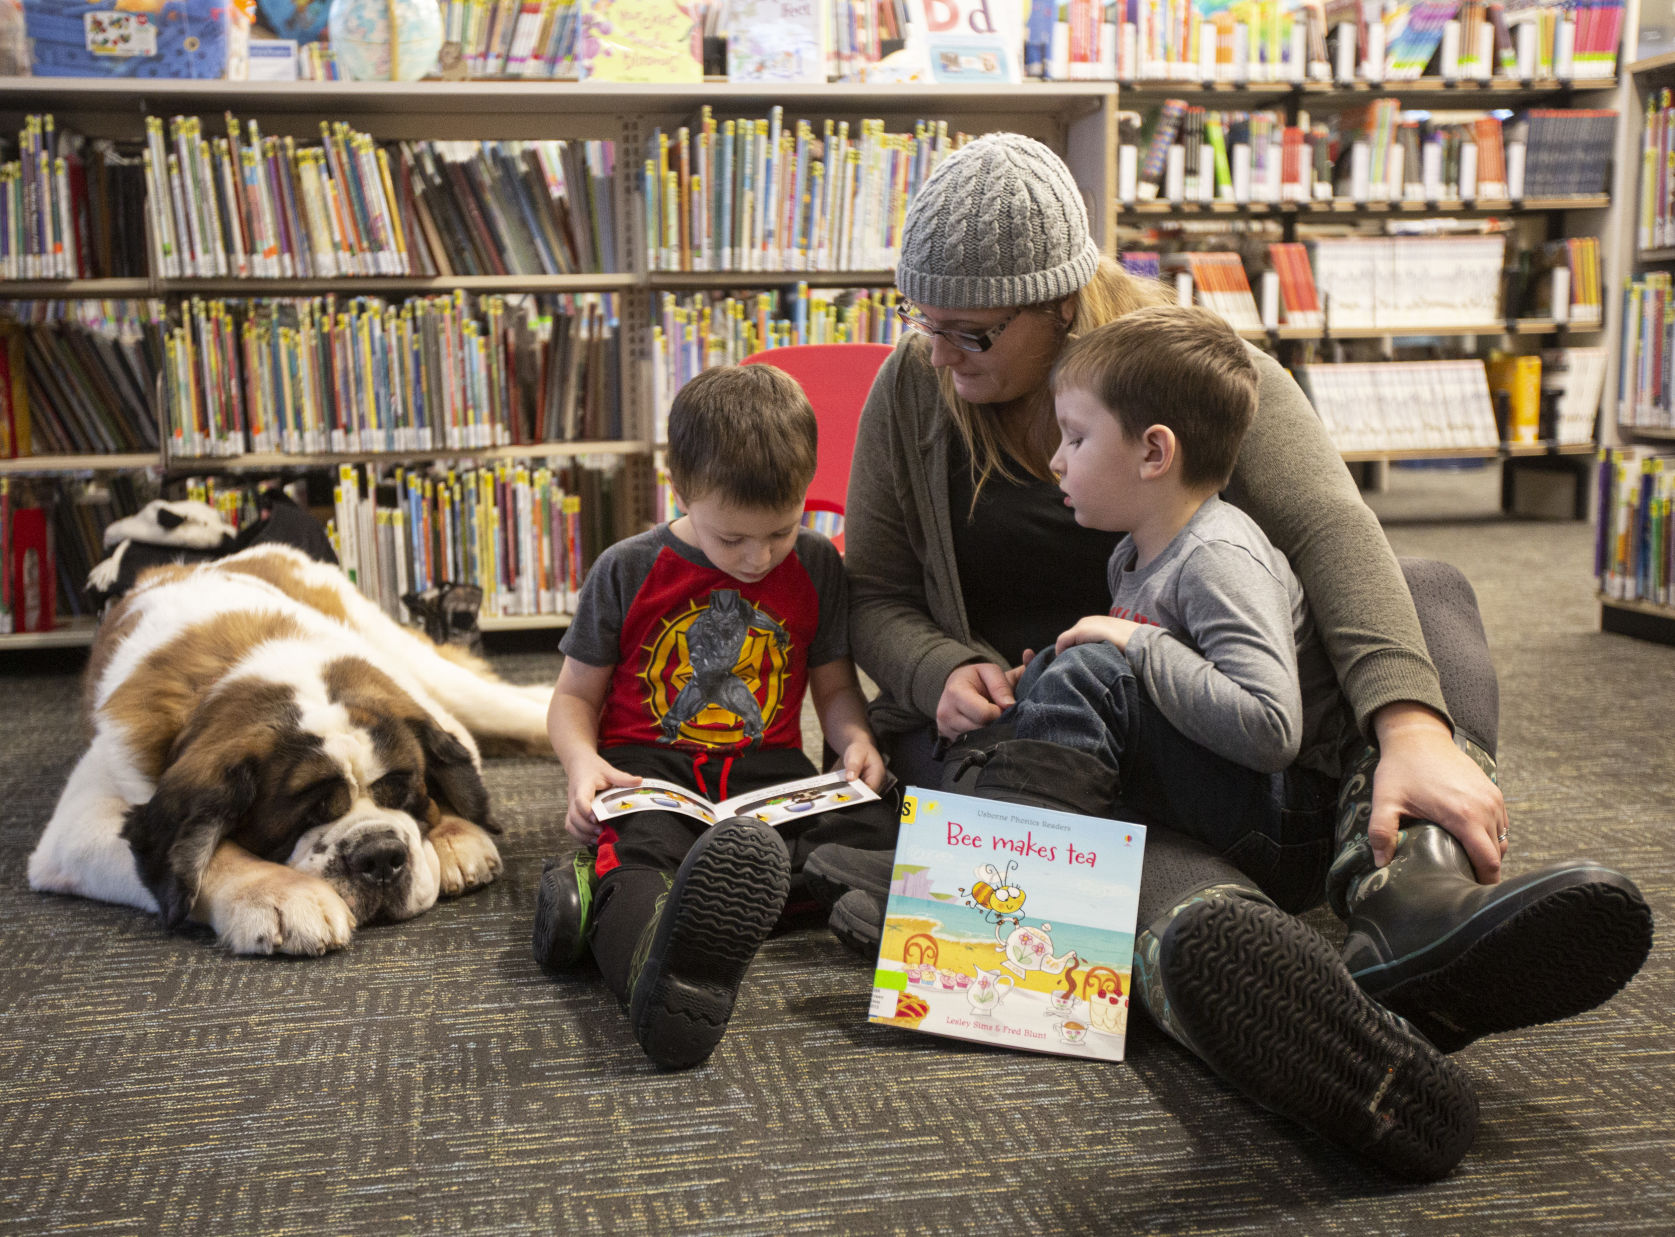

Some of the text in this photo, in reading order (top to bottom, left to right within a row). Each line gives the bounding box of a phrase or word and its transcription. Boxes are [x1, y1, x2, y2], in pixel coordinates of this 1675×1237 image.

[977, 809, 1071, 832] Usborne Phonics Readers
[947, 821, 1097, 868] Bee makes tea
[946, 1016, 971, 1029] Lesley
[973, 1020, 993, 1031] Sims
[1003, 1025, 1022, 1036] Fred
[1024, 1029, 1047, 1039] Blunt
